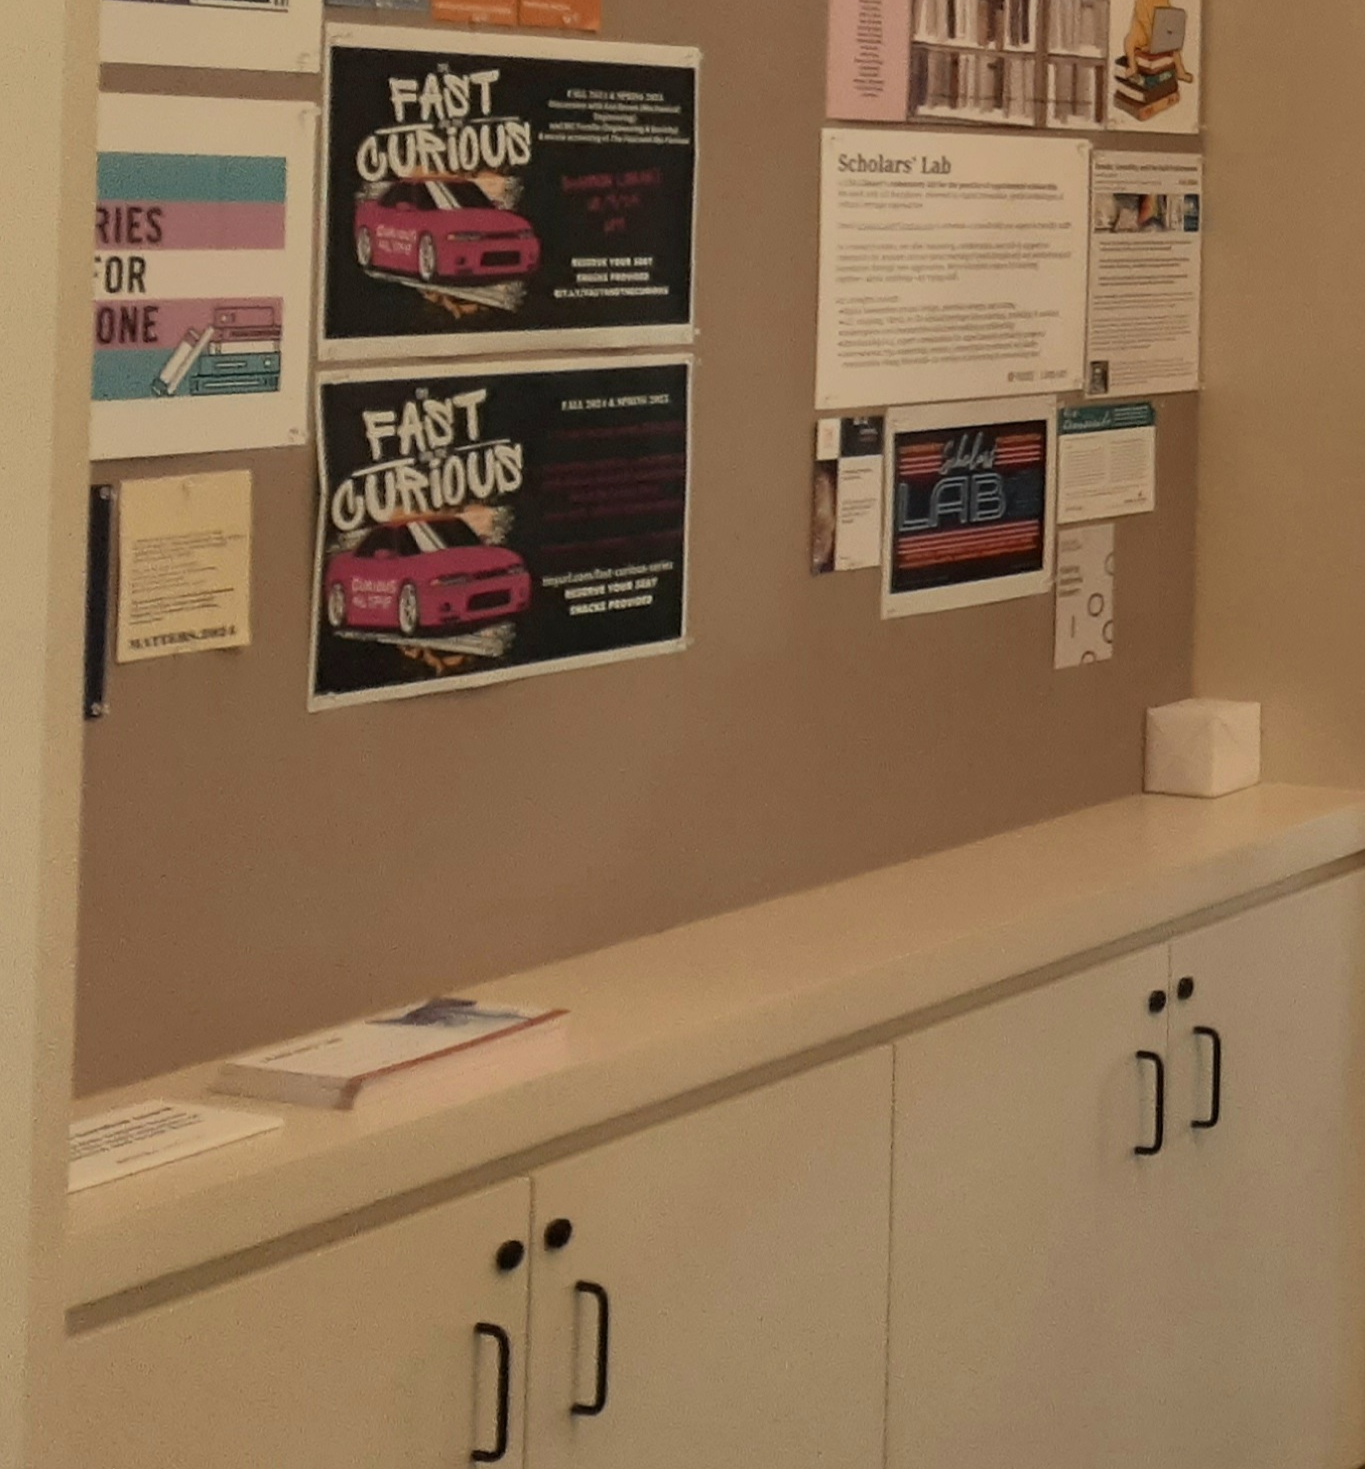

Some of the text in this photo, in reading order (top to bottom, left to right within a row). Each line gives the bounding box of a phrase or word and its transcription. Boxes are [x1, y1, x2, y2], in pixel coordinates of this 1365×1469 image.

[389, 69, 499, 122] FAST
[838, 153, 951, 174] Scholars' Lab
[363, 389, 486, 460] FAST
[899, 473, 1006, 532] LAB
